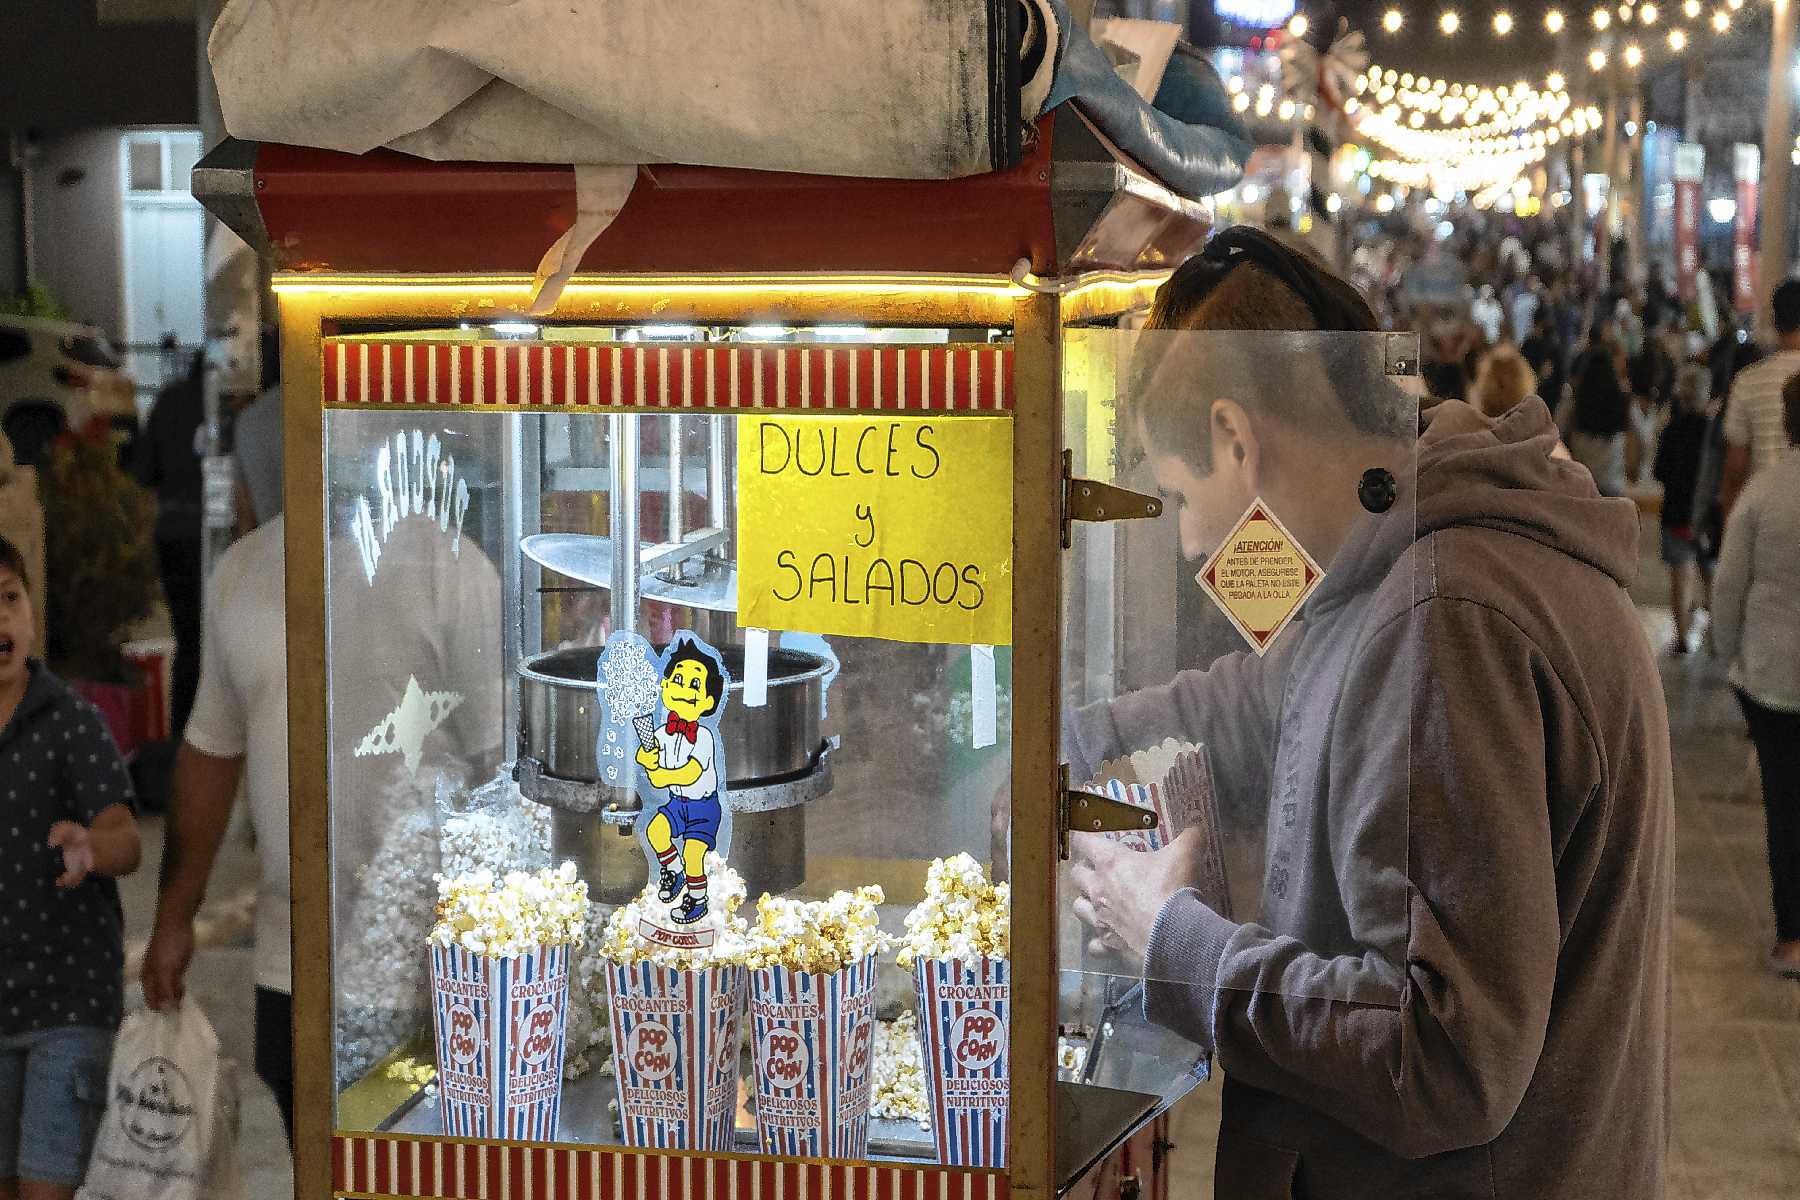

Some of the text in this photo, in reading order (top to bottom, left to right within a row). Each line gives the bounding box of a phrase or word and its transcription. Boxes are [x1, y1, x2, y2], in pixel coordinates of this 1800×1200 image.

[759, 422, 940, 478] DULCES
[1226, 557, 1248, 566] ANTES
[1249, 557, 1260, 566] DE
[772, 550, 985, 610] SALADOS
[1221, 569, 1230, 578] EL
[1220, 580, 1235, 588] QUE
[1236, 580, 1244, 588] LA
[1246, 579, 1269, 588] PALETA
[1228, 591, 1256, 600] PEGADA
[1257, 591, 1263, 599] A
[1264, 591, 1272, 599] LA
[651, 929, 672, 943] POP
[437, 978, 489, 999] CROCANTES
[938, 986, 1008, 1000] CROCANTE
[615, 995, 687, 1013] CROCANTES
[751, 1000, 819, 1019] CROCANTES
[452, 1010, 473, 1036] POP
[530, 1010, 553, 1036] POP
[963, 1016, 996, 1040] POP
[450, 1033, 475, 1057] CORN
[523, 1032, 553, 1059] CORN
[638, 1027, 667, 1051] POP
[769, 1035, 798, 1059] POP
[956, 1039, 998, 1062] CORN
[634, 1050, 671, 1073] CORN
[766, 1058, 802, 1081] CORN
[446, 1070, 489, 1089] DELICIOSOS
[510, 1069, 558, 1089] DELICIOSOS
[946, 1079, 1009, 1091] DELICIOSOS
[446, 1088, 491, 1106] NUTRITIVOS
[510, 1086, 559, 1106] NUTRITIVOS
[627, 1087, 687, 1102] DELICIOSOS
[760, 1094, 817, 1111] DELICIOSOS
[627, 1104, 689, 1120] NUTRITIVOS
[760, 1112, 821, 1128] NUTRITIVOS
